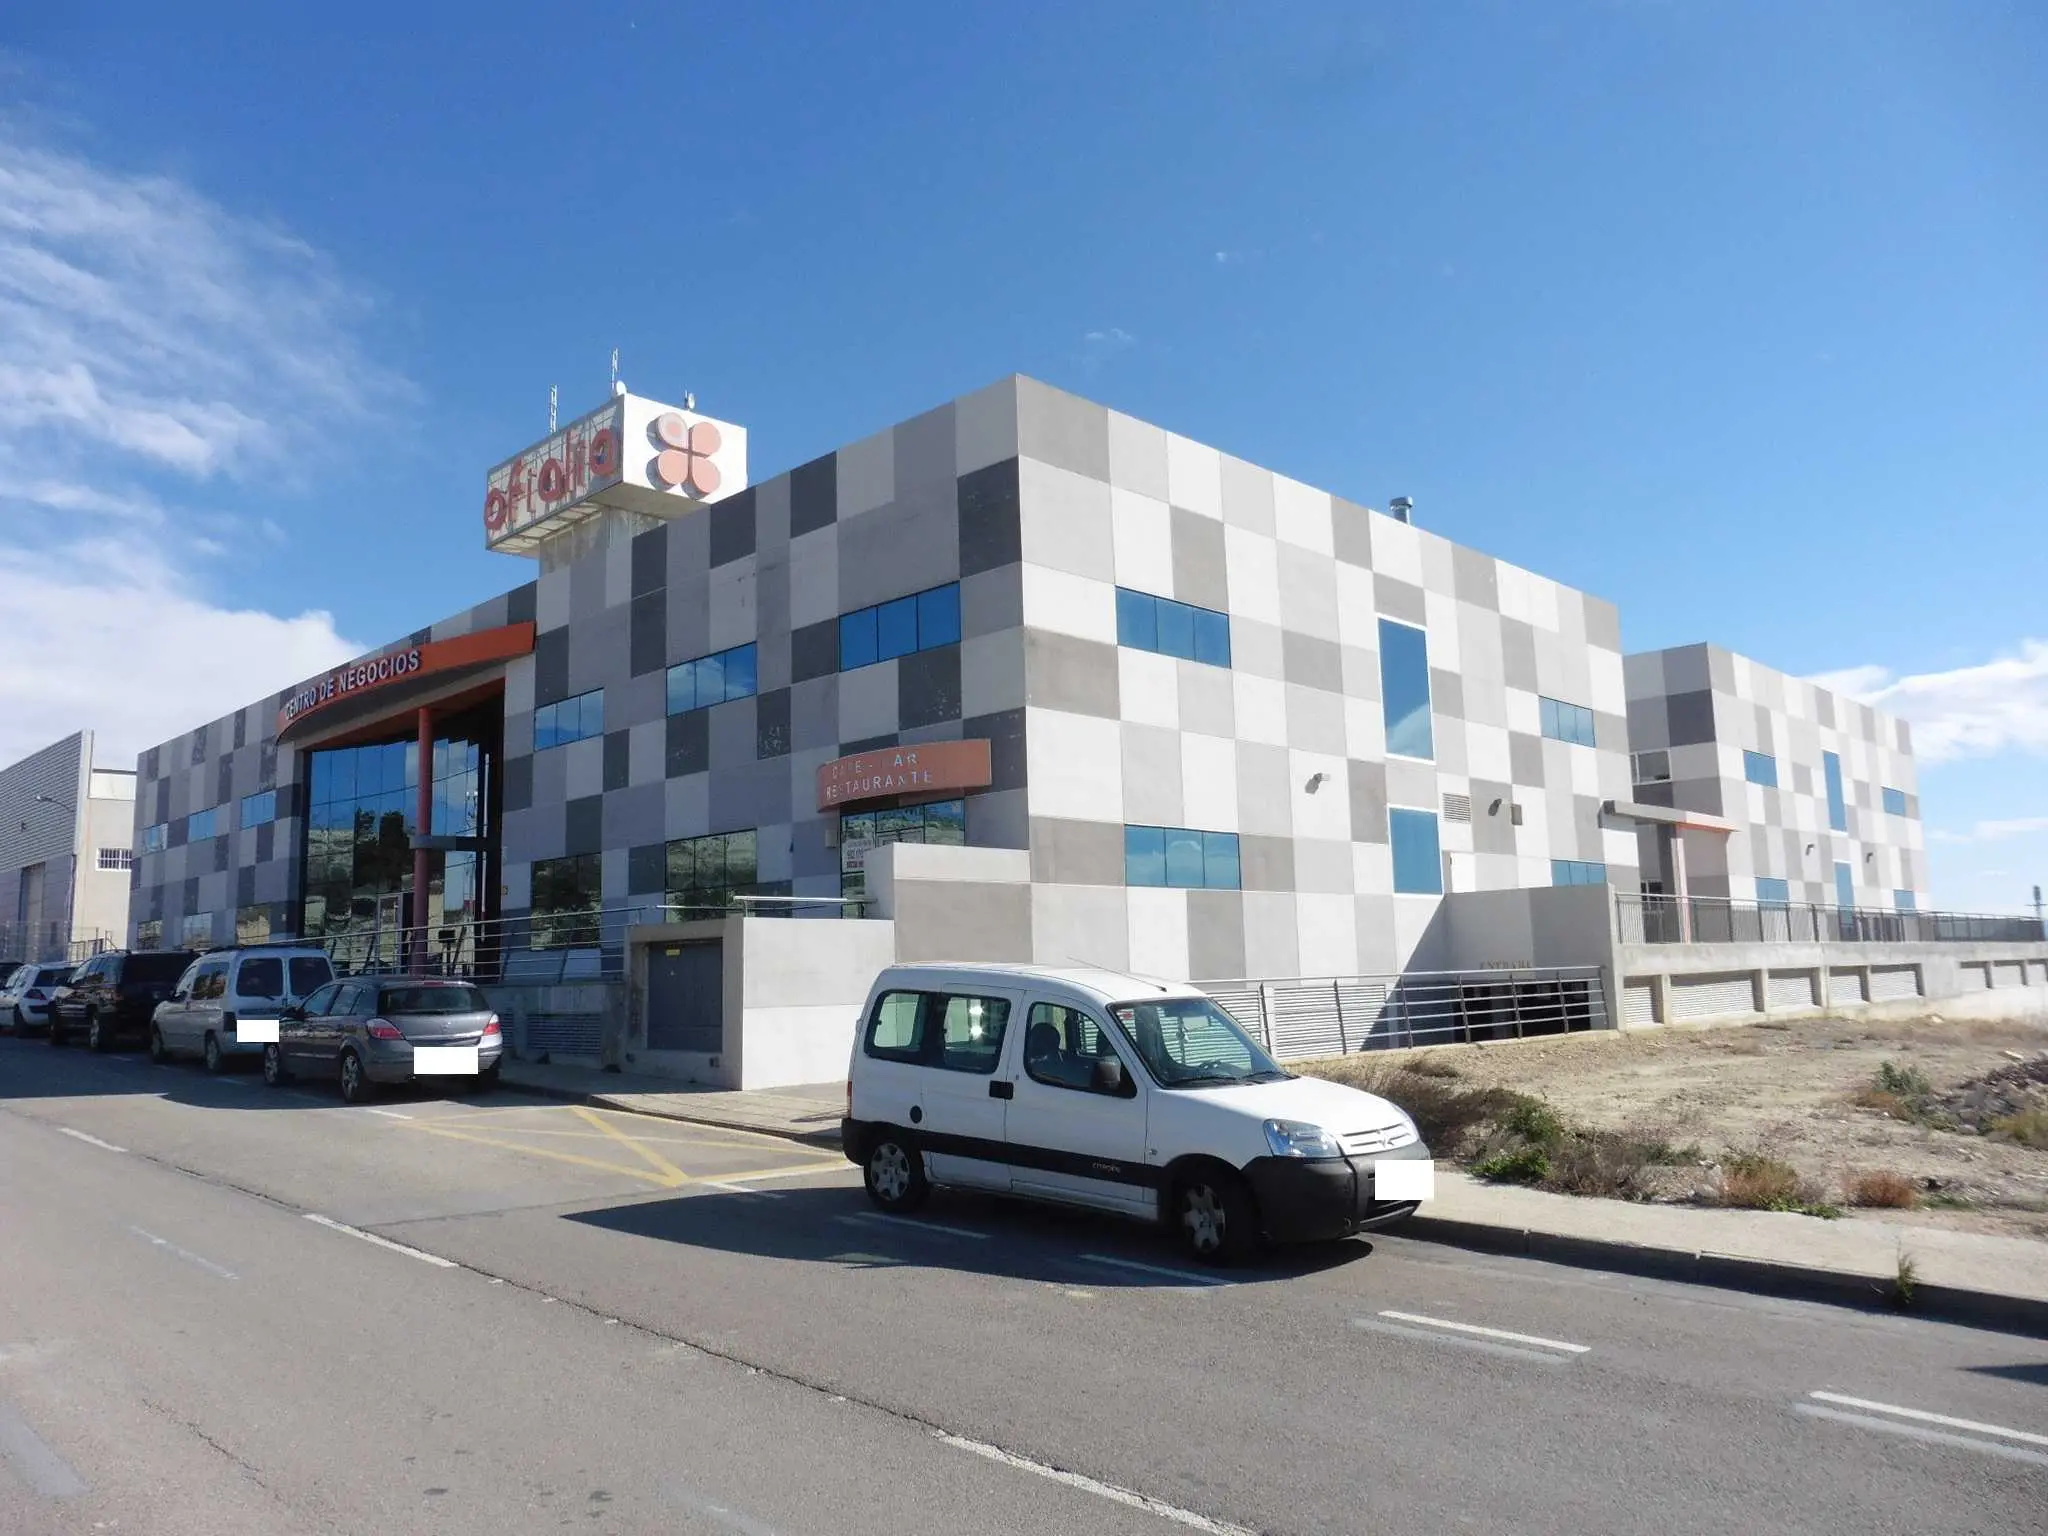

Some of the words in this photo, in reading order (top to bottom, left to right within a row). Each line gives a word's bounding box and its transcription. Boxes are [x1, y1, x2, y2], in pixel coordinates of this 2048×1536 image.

[285, 685, 317, 720] CENTRO
[319, 670, 336, 701] DE
[338, 648, 421, 693] NEGOCIOS
